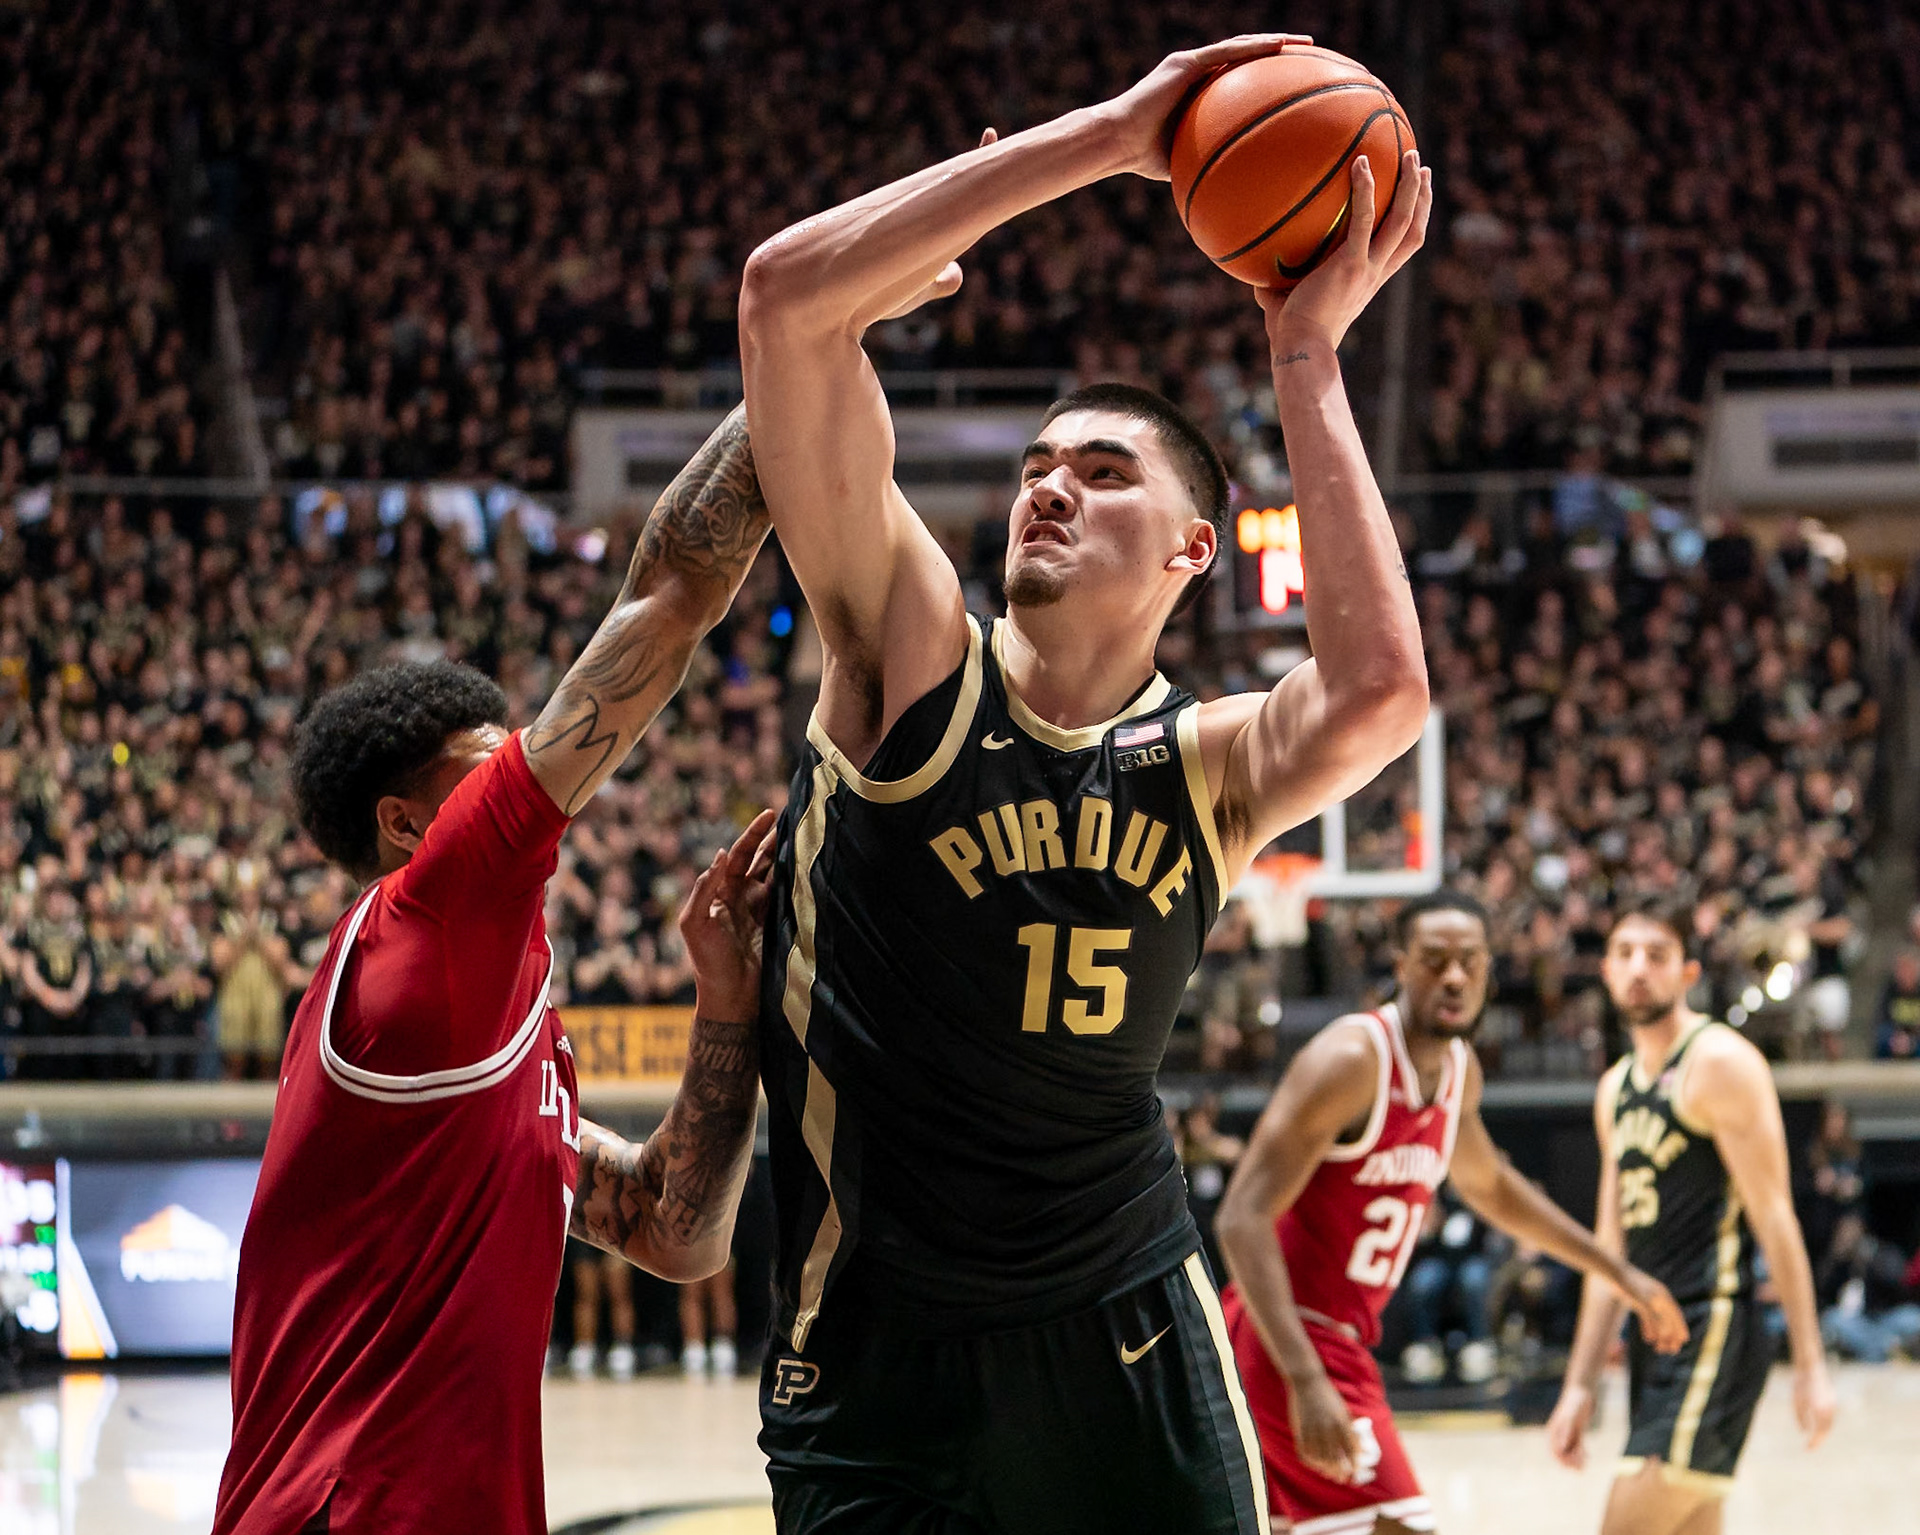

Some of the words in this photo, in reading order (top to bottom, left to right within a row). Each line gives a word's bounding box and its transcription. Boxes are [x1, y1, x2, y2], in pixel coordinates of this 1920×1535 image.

[929, 796, 1193, 918] PURDUE
[1018, 923, 1132, 1035] 15
[1346, 1195, 1425, 1288] 21
[772, 1359, 821, 1405] P
